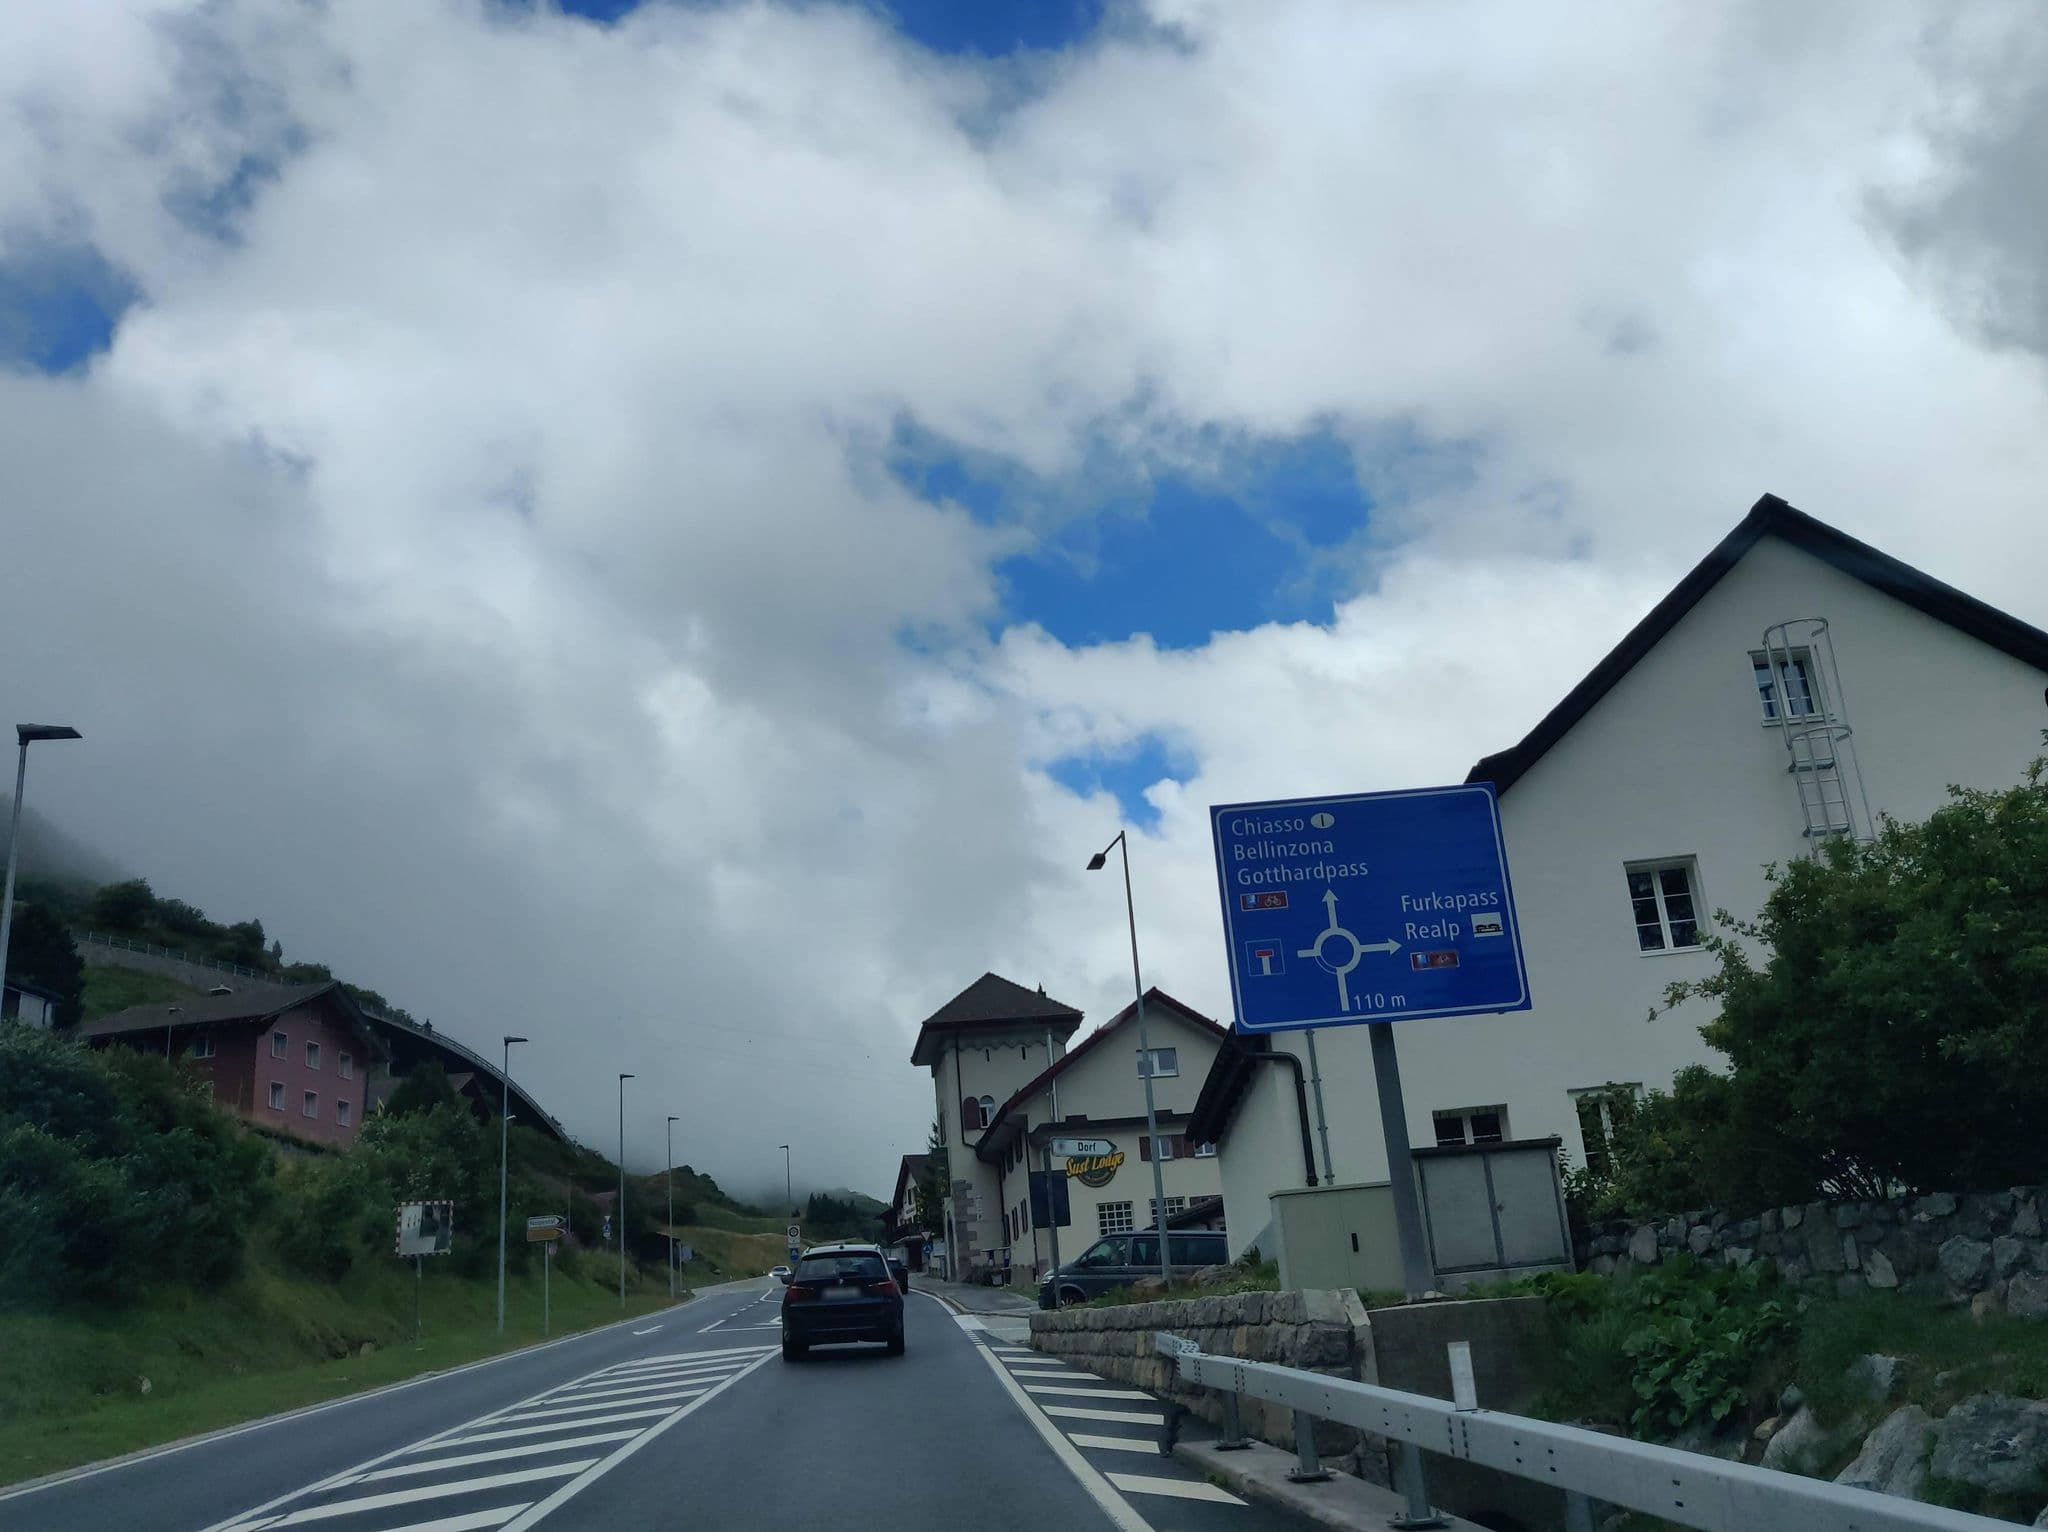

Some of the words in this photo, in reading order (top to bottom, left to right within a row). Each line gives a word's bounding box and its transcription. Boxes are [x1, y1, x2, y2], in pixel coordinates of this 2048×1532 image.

[1231, 816, 1305, 837] Chiasso
[1234, 837, 1334, 861] Bellinzona
[1237, 861, 1369, 886] Gotthardpass
[1401, 889, 1498, 913] Furkapass
[1405, 919, 1461, 942] Realp
[1354, 993, 1385, 1011] 110
[1391, 994, 1407, 1008] m
[1077, 1142, 1097, 1152] Dorf
